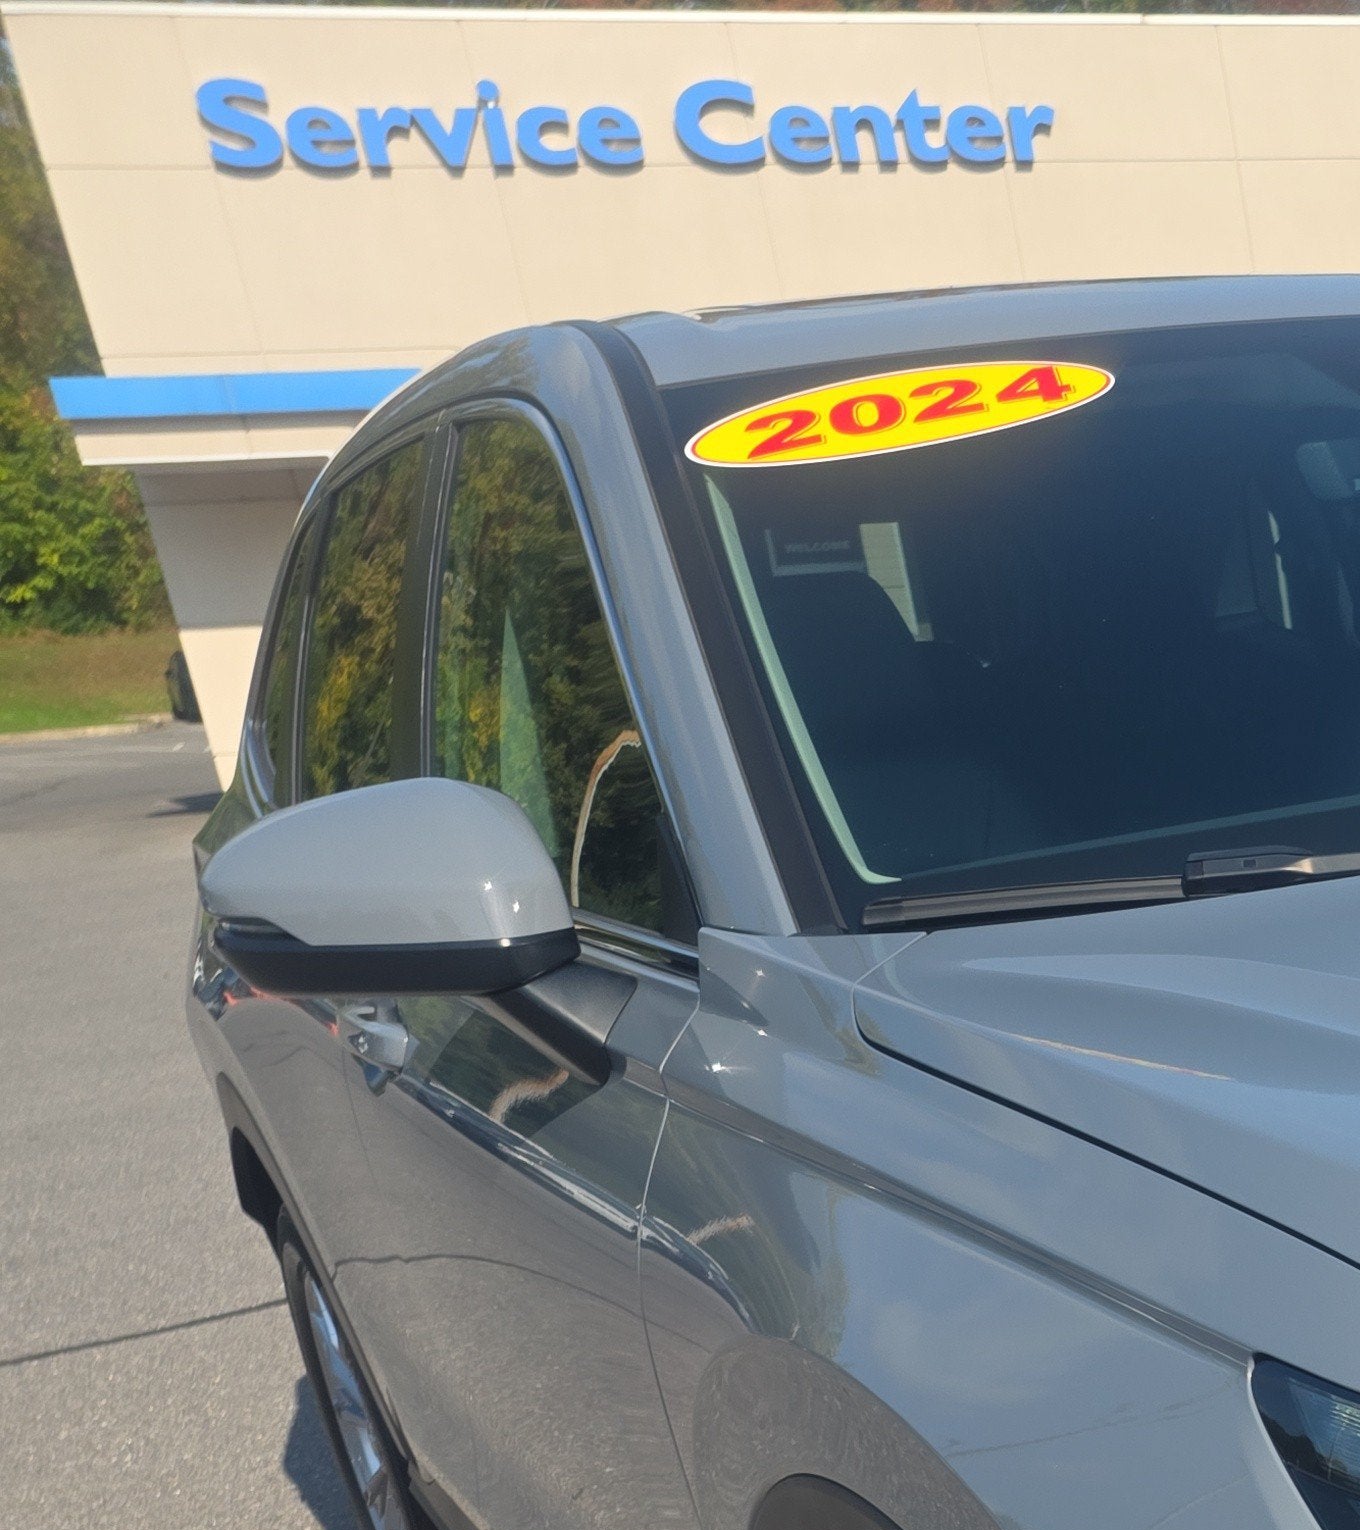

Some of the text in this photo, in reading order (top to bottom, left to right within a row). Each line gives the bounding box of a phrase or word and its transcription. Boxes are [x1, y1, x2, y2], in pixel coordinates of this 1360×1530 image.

[195, 77, 1055, 173] Service Center
[745, 365, 1075, 461] 2024
